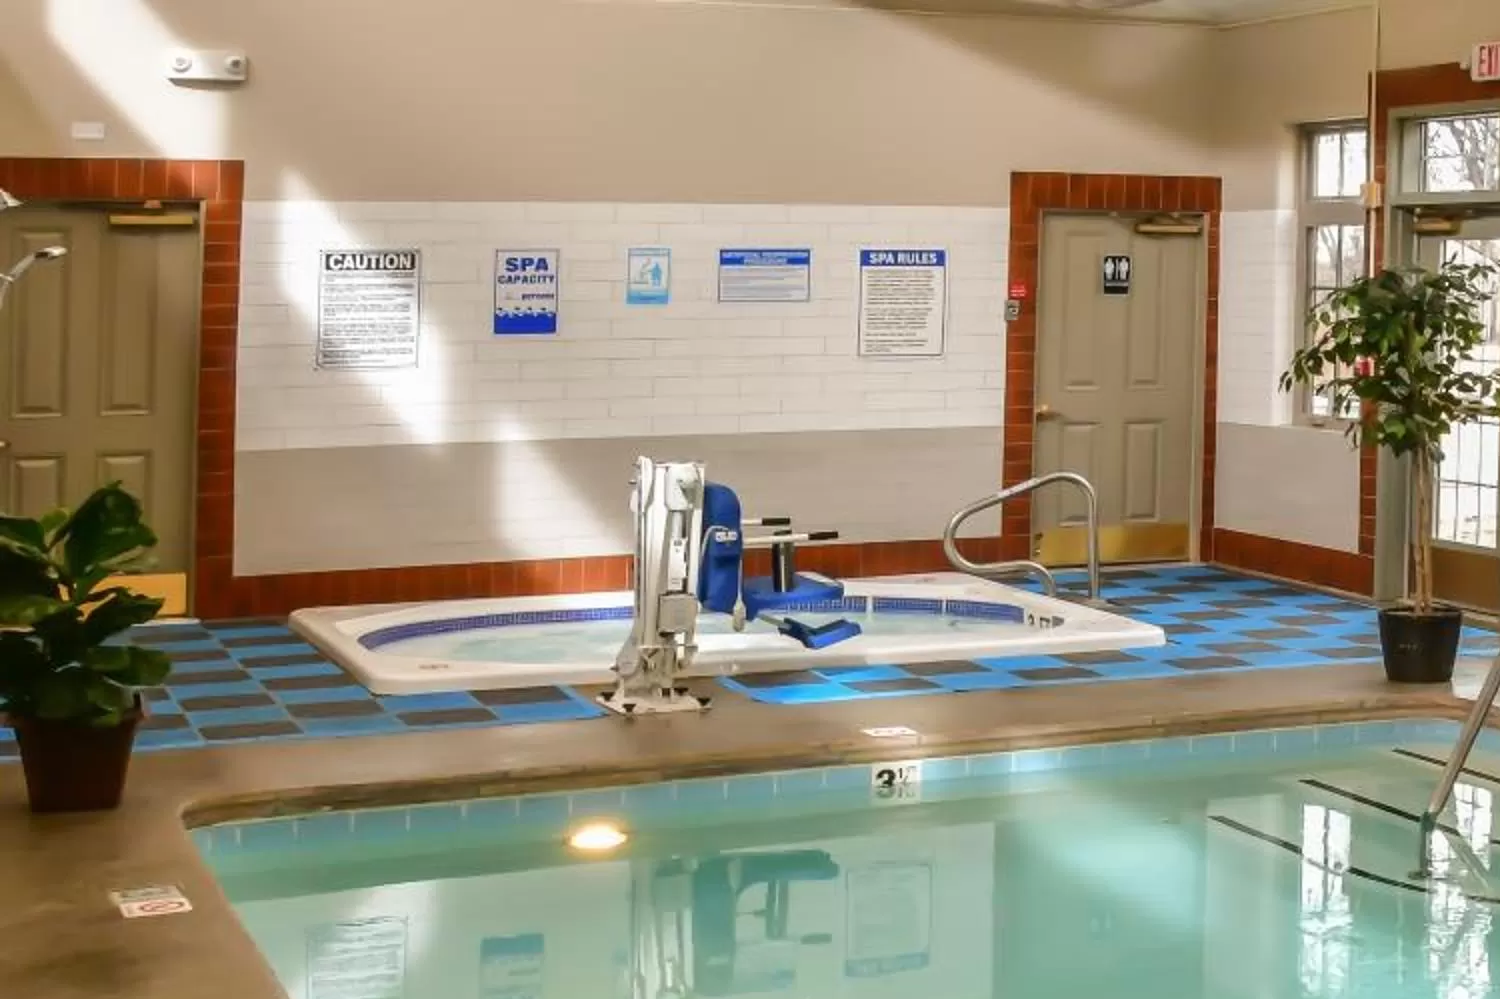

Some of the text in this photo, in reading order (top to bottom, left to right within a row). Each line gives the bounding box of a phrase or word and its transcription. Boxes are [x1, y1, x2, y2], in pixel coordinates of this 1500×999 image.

[328, 254, 412, 269] CAUTION
[505, 257, 549, 272] SPA
[869, 252, 938, 265] SPA RULES
[497, 275, 555, 285] CAPACITY
